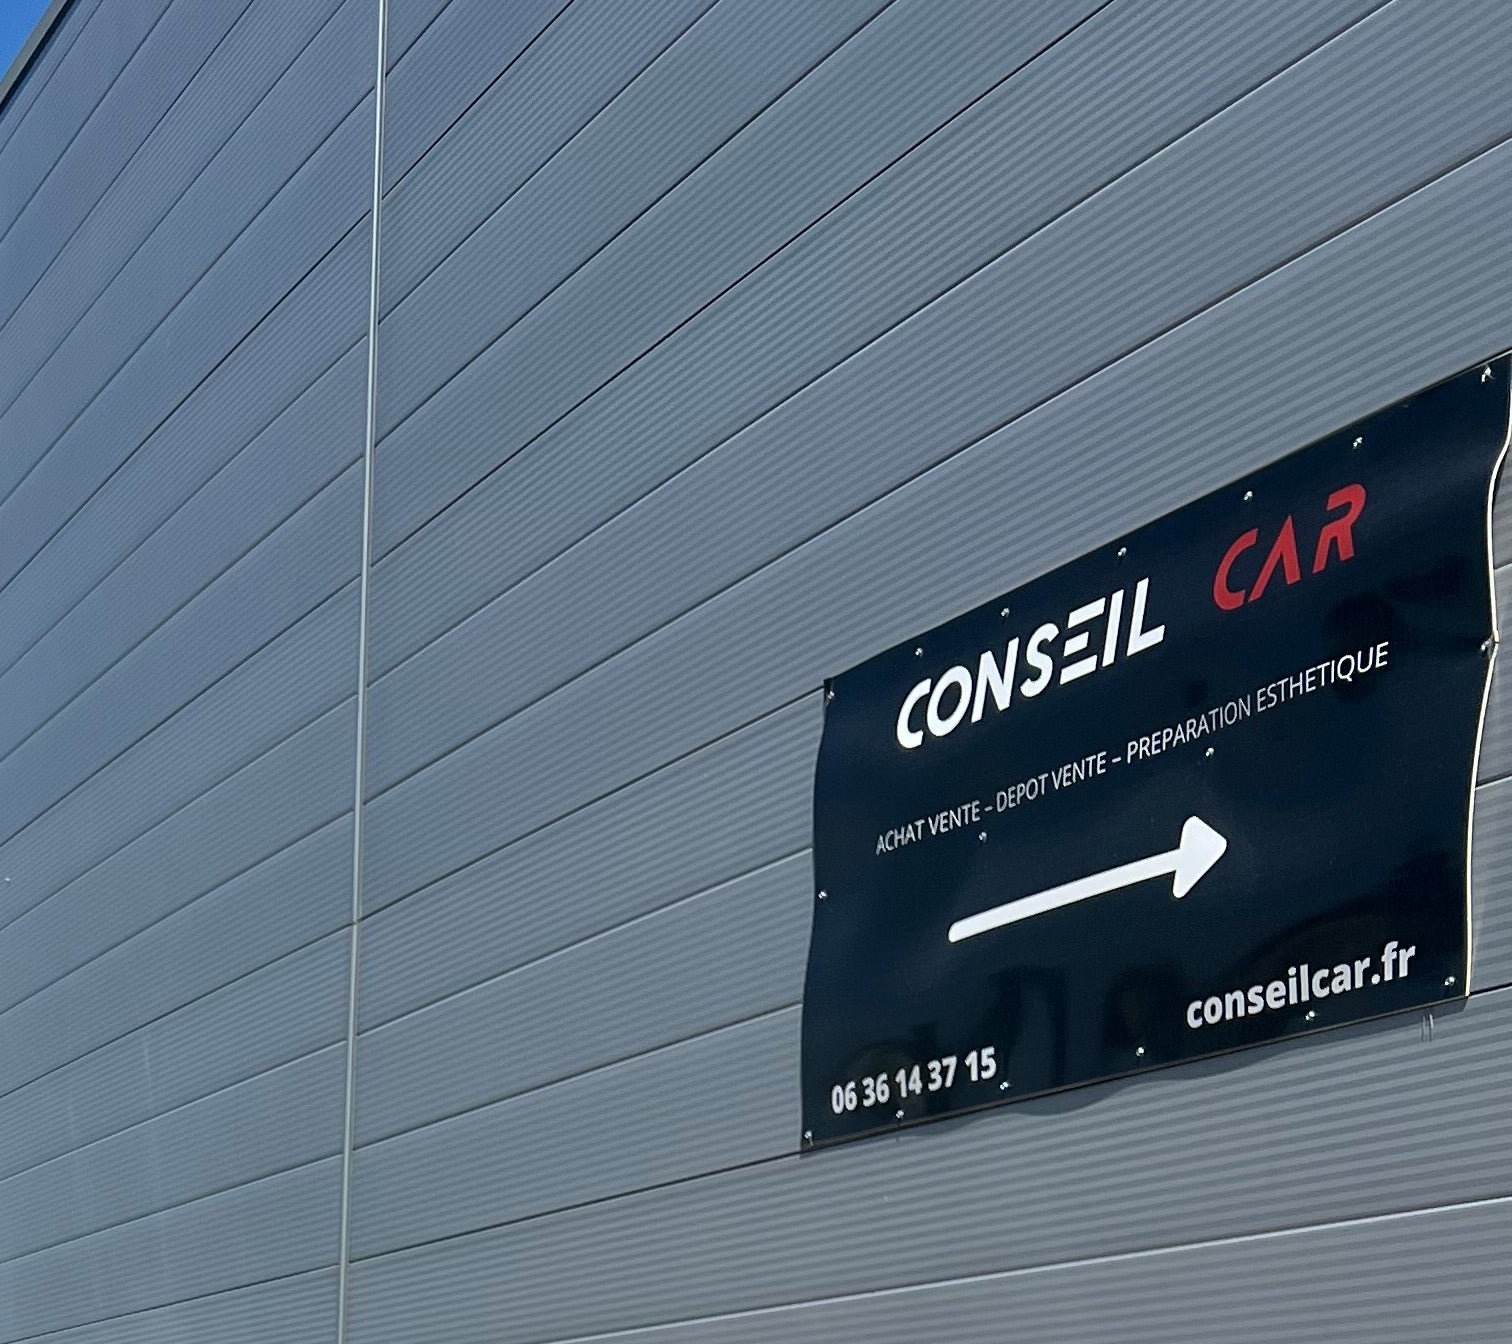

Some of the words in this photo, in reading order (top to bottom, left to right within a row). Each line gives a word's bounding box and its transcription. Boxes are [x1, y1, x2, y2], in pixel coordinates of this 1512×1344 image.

[896, 576, 1165, 749] CONSEIL
[1213, 483, 1367, 612] CAR
[875, 818, 926, 856] ACHAT
[927, 800, 981, 836] VENTE
[996, 773, 1049, 813] DEPOT
[1050, 751, 1108, 790] VENTE
[1126, 694, 1251, 764] PREPARATION
[1256, 641, 1389, 713] ESTHETIQUE
[1186, 940, 1417, 1029] conseilcar.fr
[831, 1080, 858, 1115] 06
[861, 1071, 890, 1108] 36
[894, 1064, 924, 1099] 14
[927, 1055, 958, 1092] 37
[964, 1045, 997, 1083] 15
